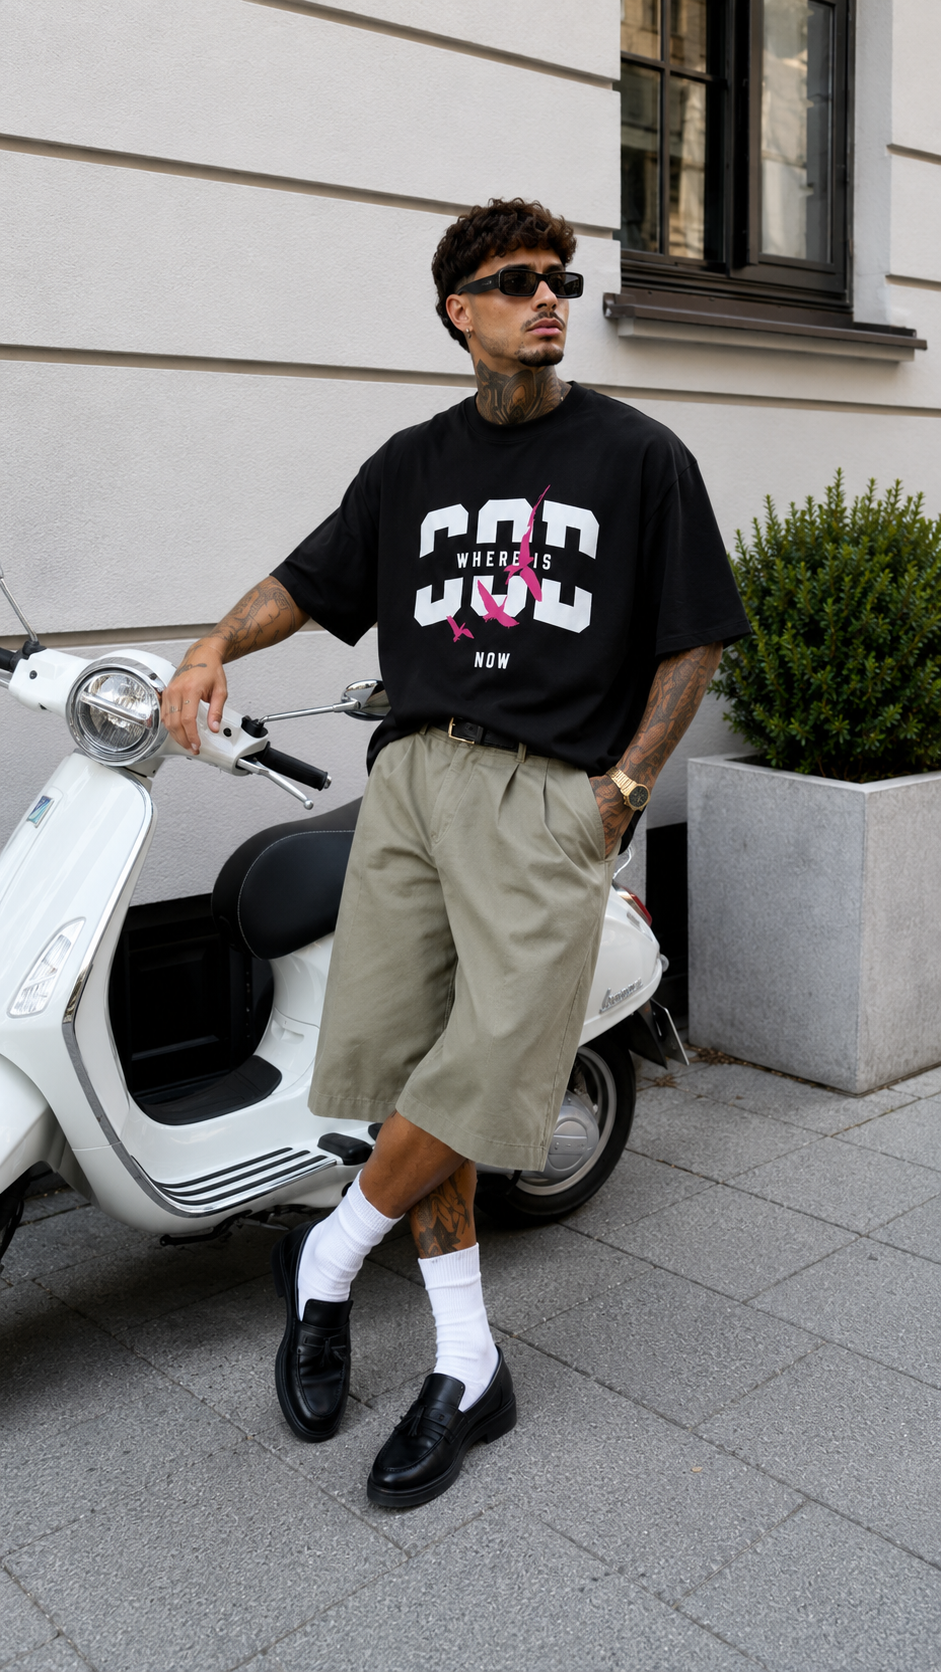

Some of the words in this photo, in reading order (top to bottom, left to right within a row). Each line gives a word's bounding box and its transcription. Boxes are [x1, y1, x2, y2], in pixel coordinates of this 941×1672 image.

[456, 551, 521, 569] WHERE
[533, 552, 552, 571] IS
[474, 651, 510, 670] NOW
